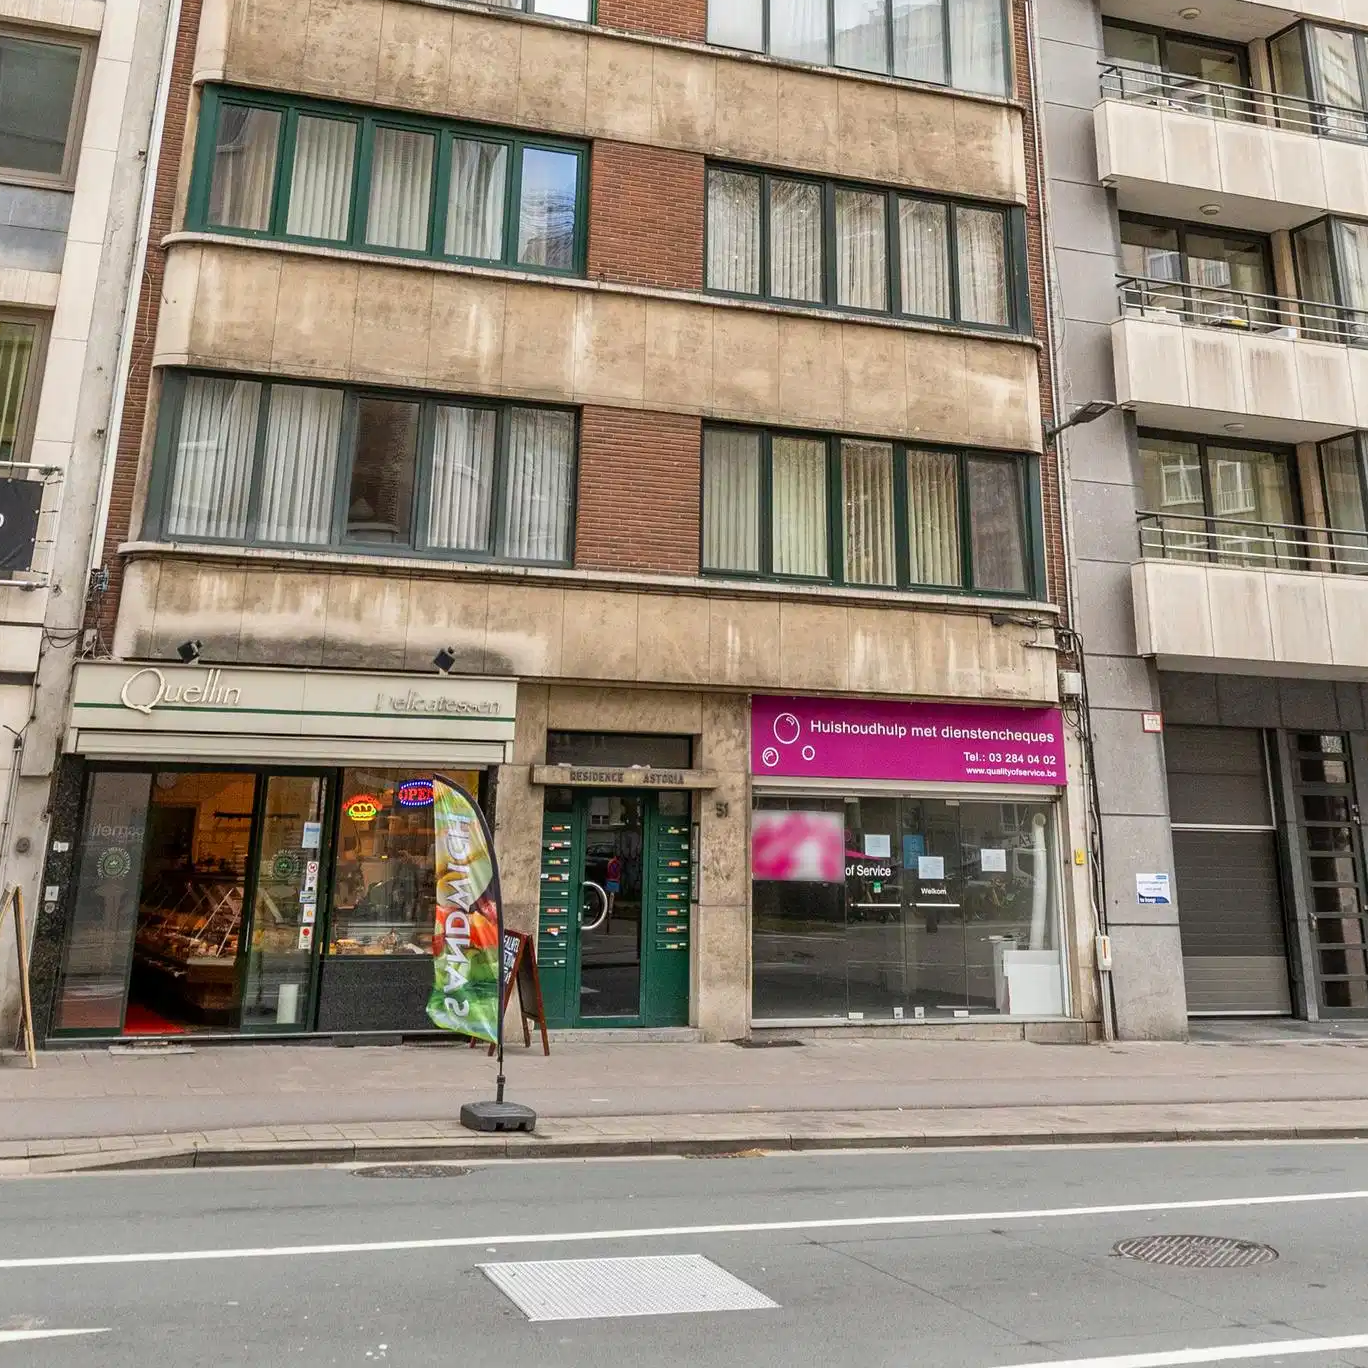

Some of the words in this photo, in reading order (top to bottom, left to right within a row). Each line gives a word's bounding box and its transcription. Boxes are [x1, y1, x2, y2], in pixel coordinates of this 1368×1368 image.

[120, 667, 242, 714] Quellin
[810, 720, 907, 739] Huishoudhulp
[911, 728, 937, 737] met
[941, 727, 1054, 744] dienstencheques
[964, 752, 985, 762] Tel.:
[988, 753, 1002, 763] 03
[1005, 754, 1024, 763] 284
[1027, 754, 1040, 764] 04
[1042, 755, 1056, 765] 02
[570, 772, 624, 782] RESIDENCE
[642, 774, 685, 784] ASTORIA
[966, 767, 1057, 778] www.qualityofservice.be
[845, 864, 855, 876] of
[856, 865, 892, 877] Service
